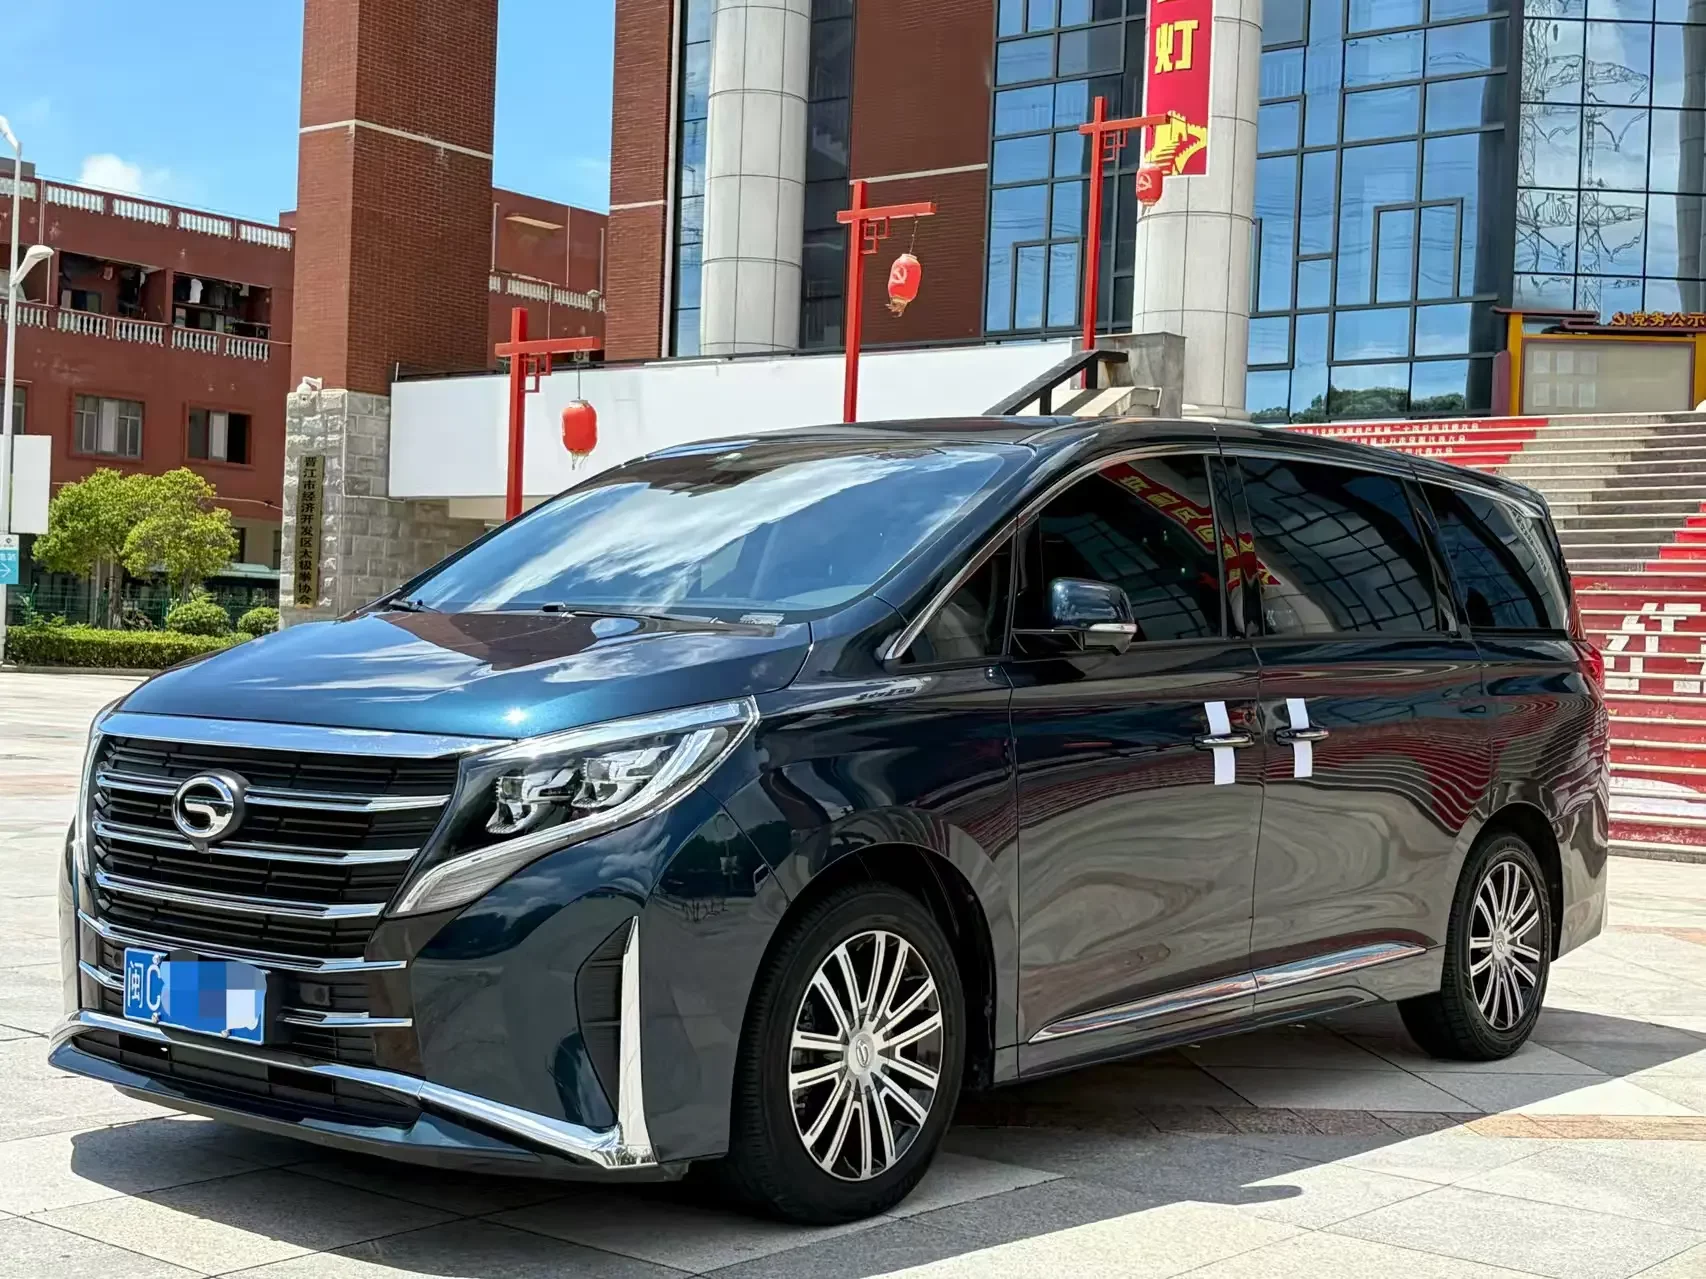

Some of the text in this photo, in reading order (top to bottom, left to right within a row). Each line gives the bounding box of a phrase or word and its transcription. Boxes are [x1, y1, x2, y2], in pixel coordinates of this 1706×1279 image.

[1154, 0, 1199, 74] 灯
[1631, 311, 1705, 327] 党务公示
[298, 456, 317, 605] 晋江市经济开发区太极拳协会
